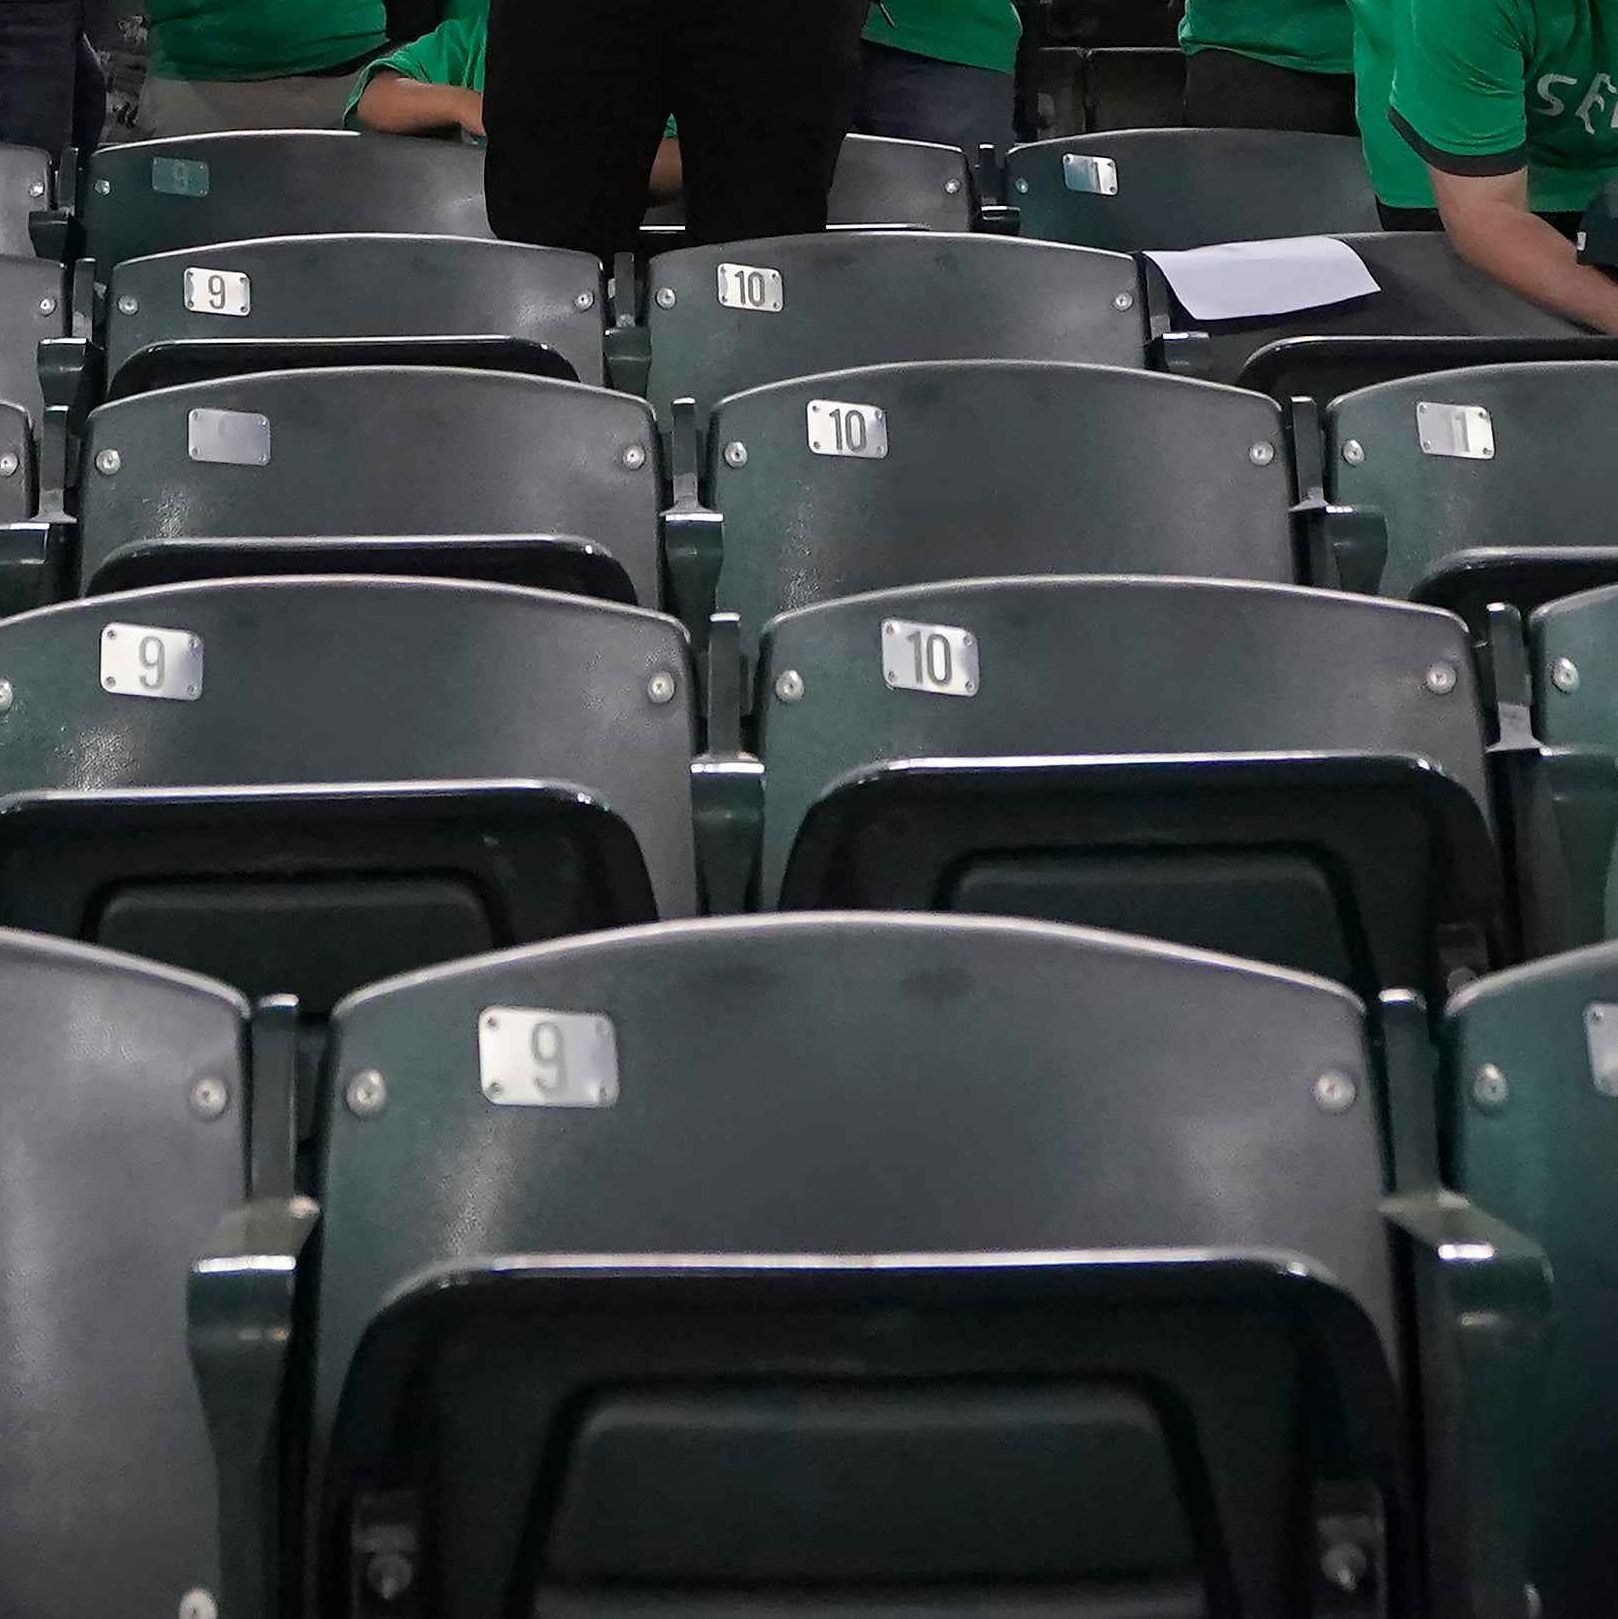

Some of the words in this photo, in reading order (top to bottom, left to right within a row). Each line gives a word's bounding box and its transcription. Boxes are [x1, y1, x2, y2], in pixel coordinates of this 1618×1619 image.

[206, 273, 227, 311] 9
[732, 268, 765, 309] 10
[828, 408, 868, 452] 10
[138, 635, 166, 691] 9
[906, 632, 952, 687] 10
[530, 1022, 565, 1095] 9
